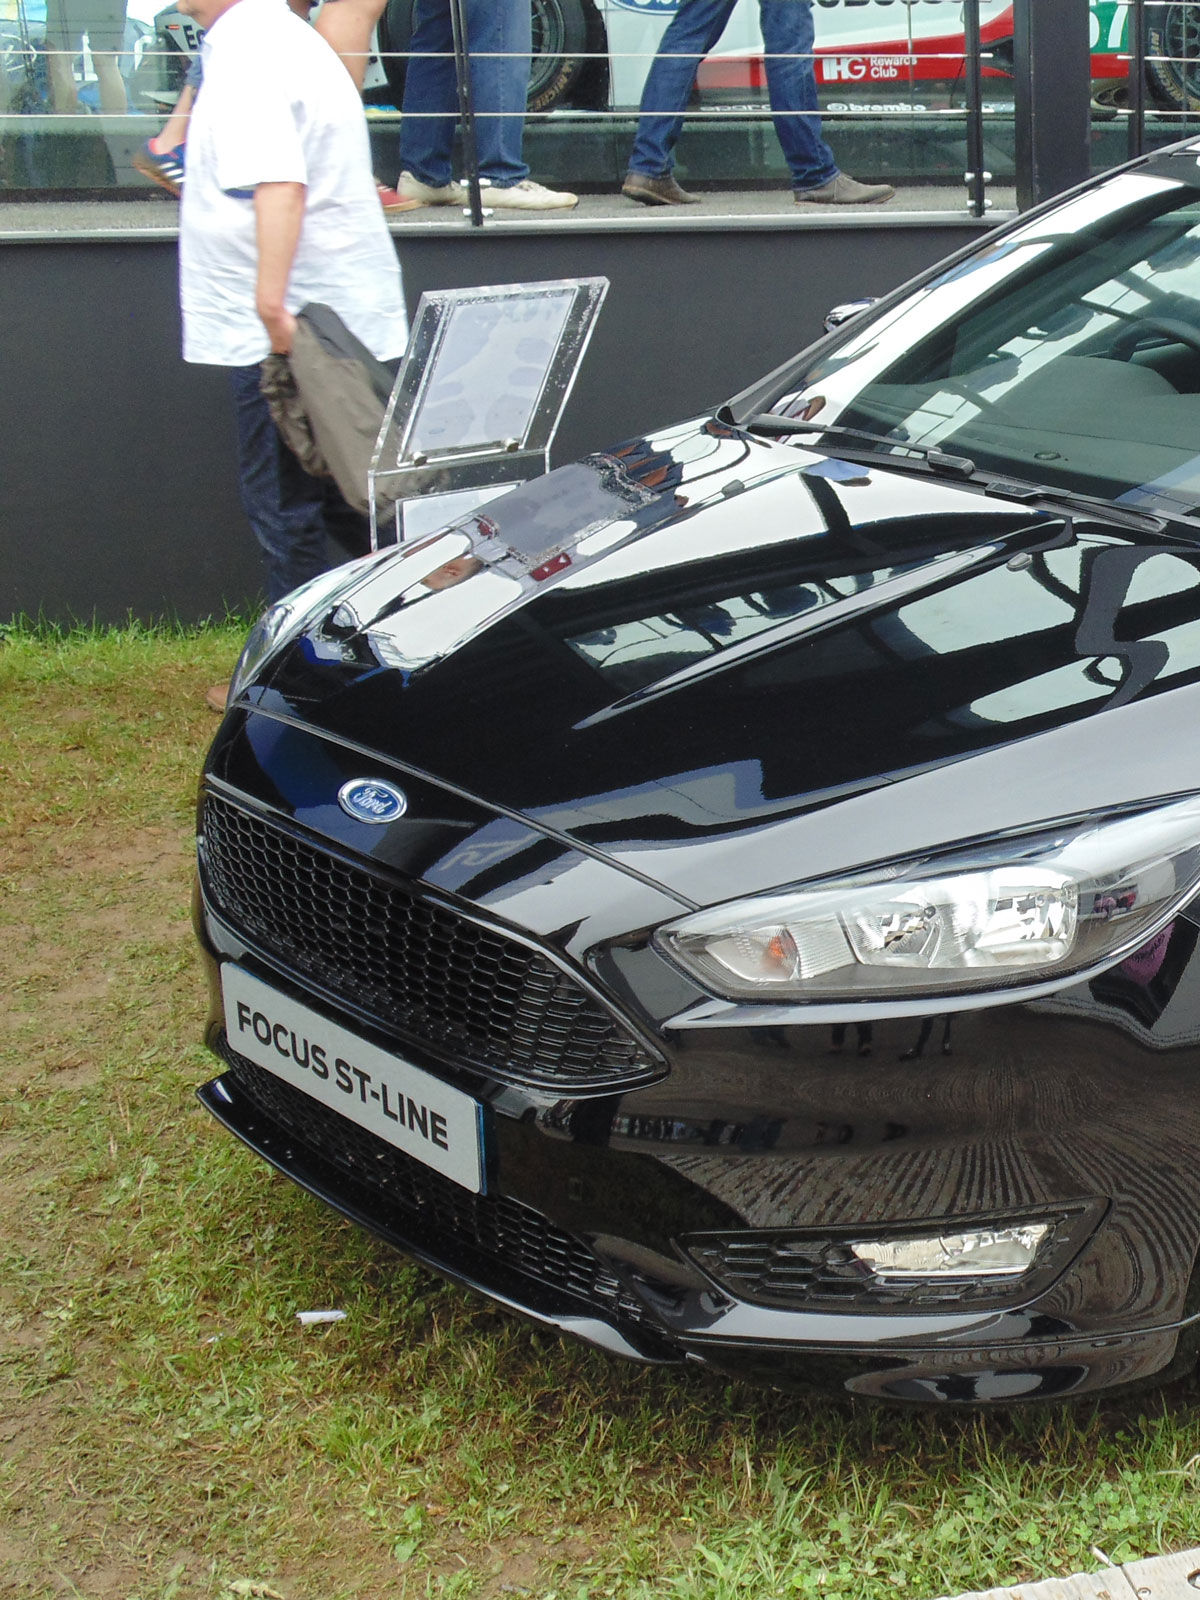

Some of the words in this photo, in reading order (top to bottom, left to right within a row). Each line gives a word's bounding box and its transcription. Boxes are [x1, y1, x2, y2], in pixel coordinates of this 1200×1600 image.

[822, 57, 867, 80] IHG
[870, 67, 898, 78] Club
[848, 103, 927, 112] brembo
[352, 786, 393, 815] Ford
[237, 1000, 330, 1080] FOCUS
[335, 1057, 450, 1151] ST-LINE
